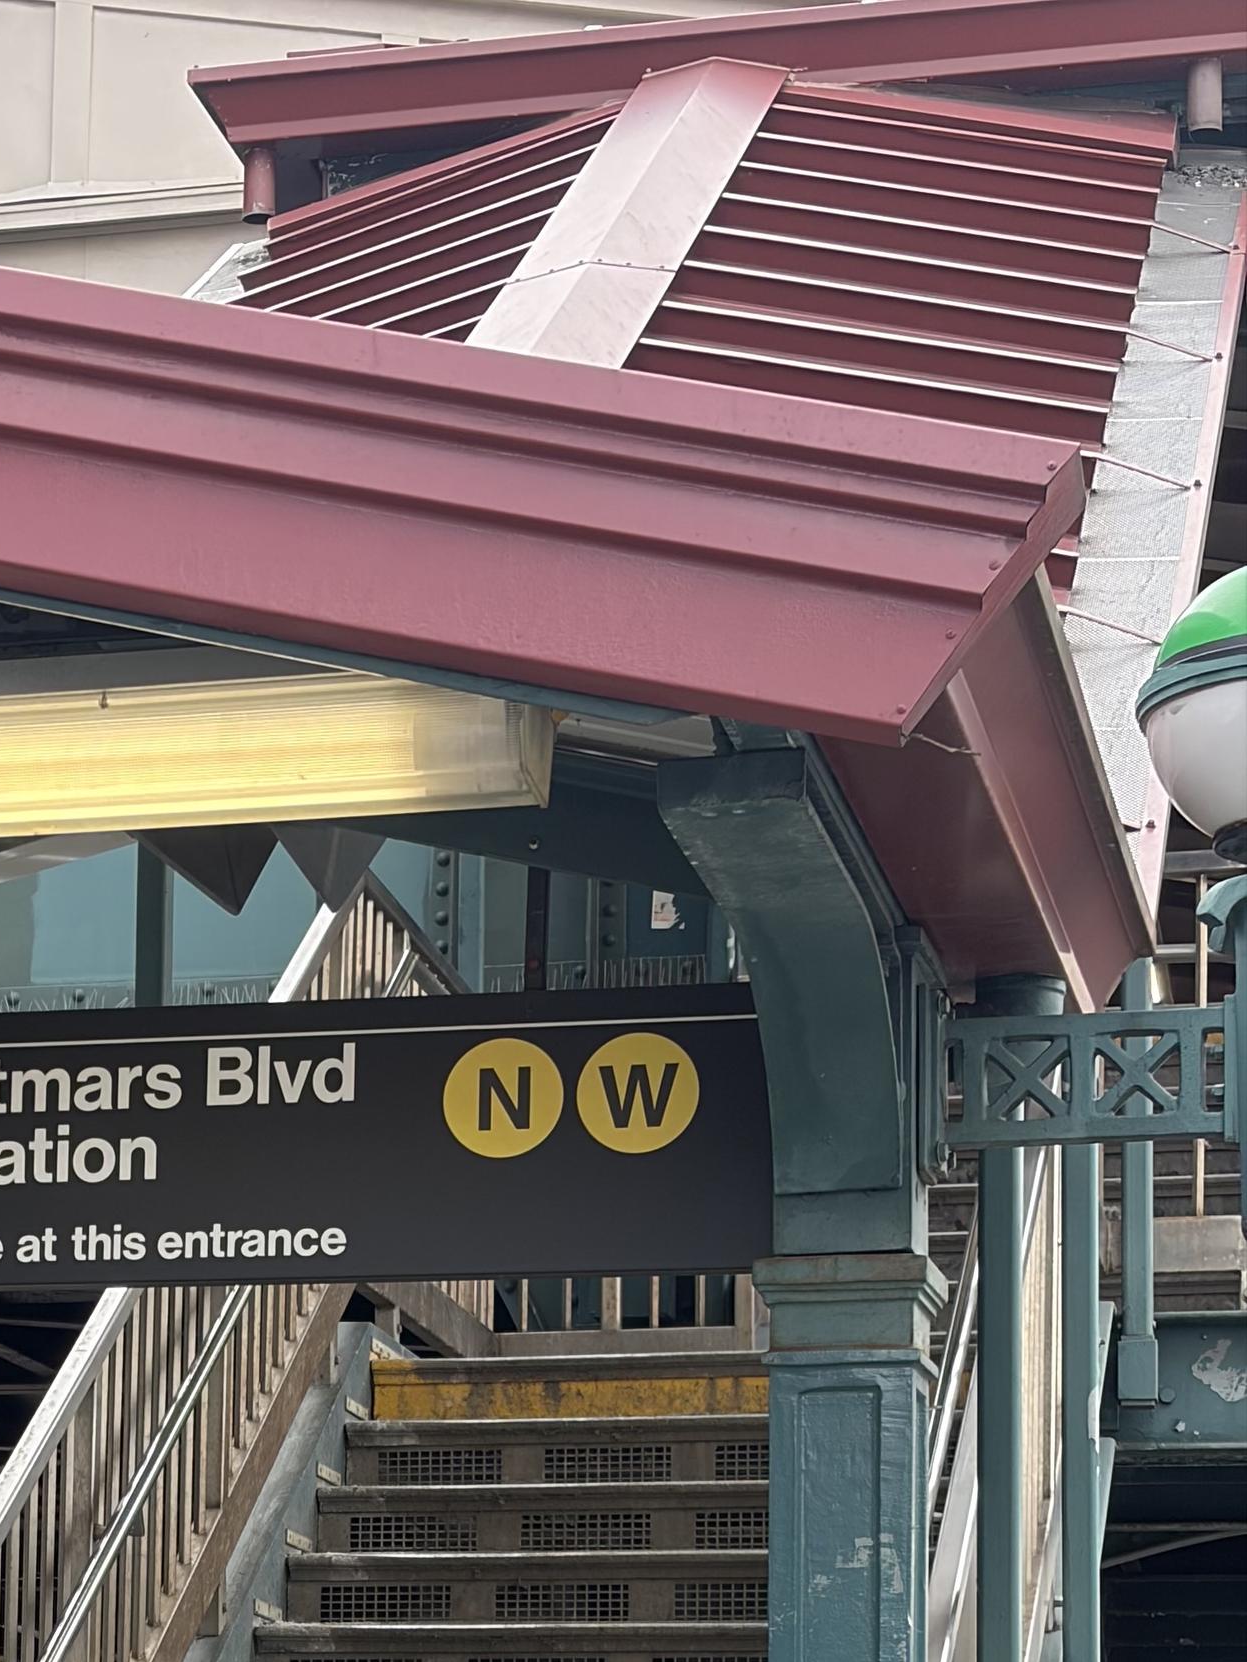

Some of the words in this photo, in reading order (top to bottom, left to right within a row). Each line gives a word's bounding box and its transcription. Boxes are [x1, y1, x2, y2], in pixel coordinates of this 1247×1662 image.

[206, 1042, 356, 1106] Blvd
[478, 1065, 532, 1131] N
[598, 1062, 680, 1129] W
[17, 1228, 58, 1263] at
[70, 1224, 147, 1261] this
[158, 1223, 347, 1260] entrance
